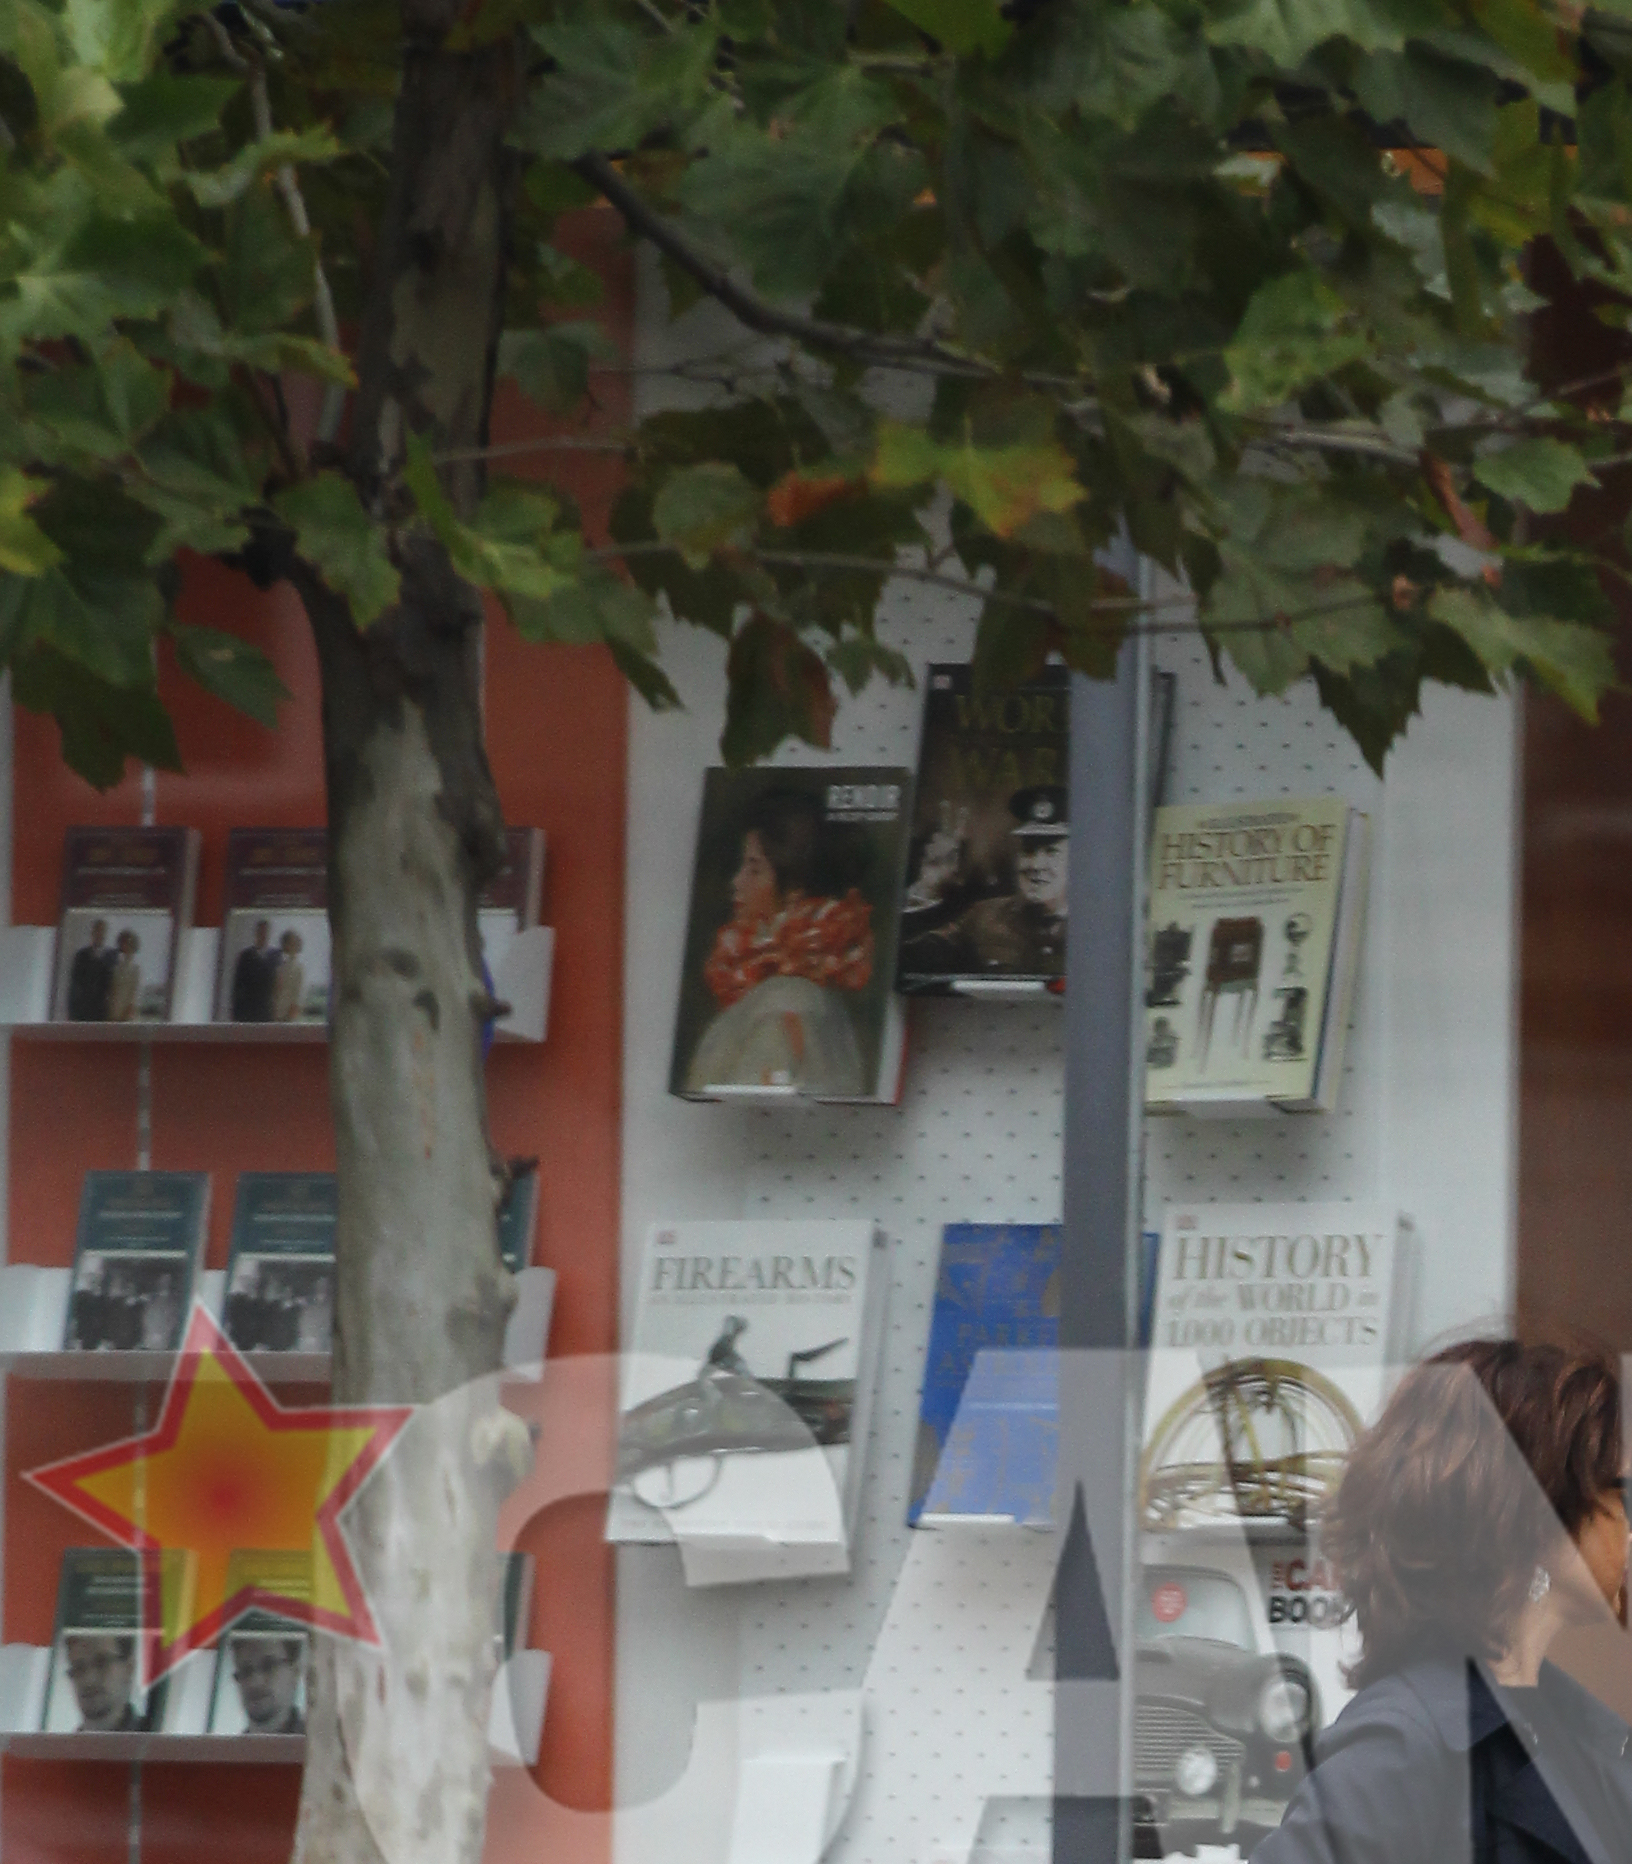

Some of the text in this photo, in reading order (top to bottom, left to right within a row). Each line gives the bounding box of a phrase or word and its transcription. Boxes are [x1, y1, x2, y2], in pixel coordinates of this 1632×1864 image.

[1160, 823, 1337, 861] HISTORY OF
[1157, 852, 1331, 890] FURNITURE
[650, 1255, 857, 1291] FIREARMS
[1172, 1234, 1389, 1280] HISTORY
[1236, 1283, 1351, 1312] WORLD
[1244, 1315, 1379, 1346] OBJECTS
